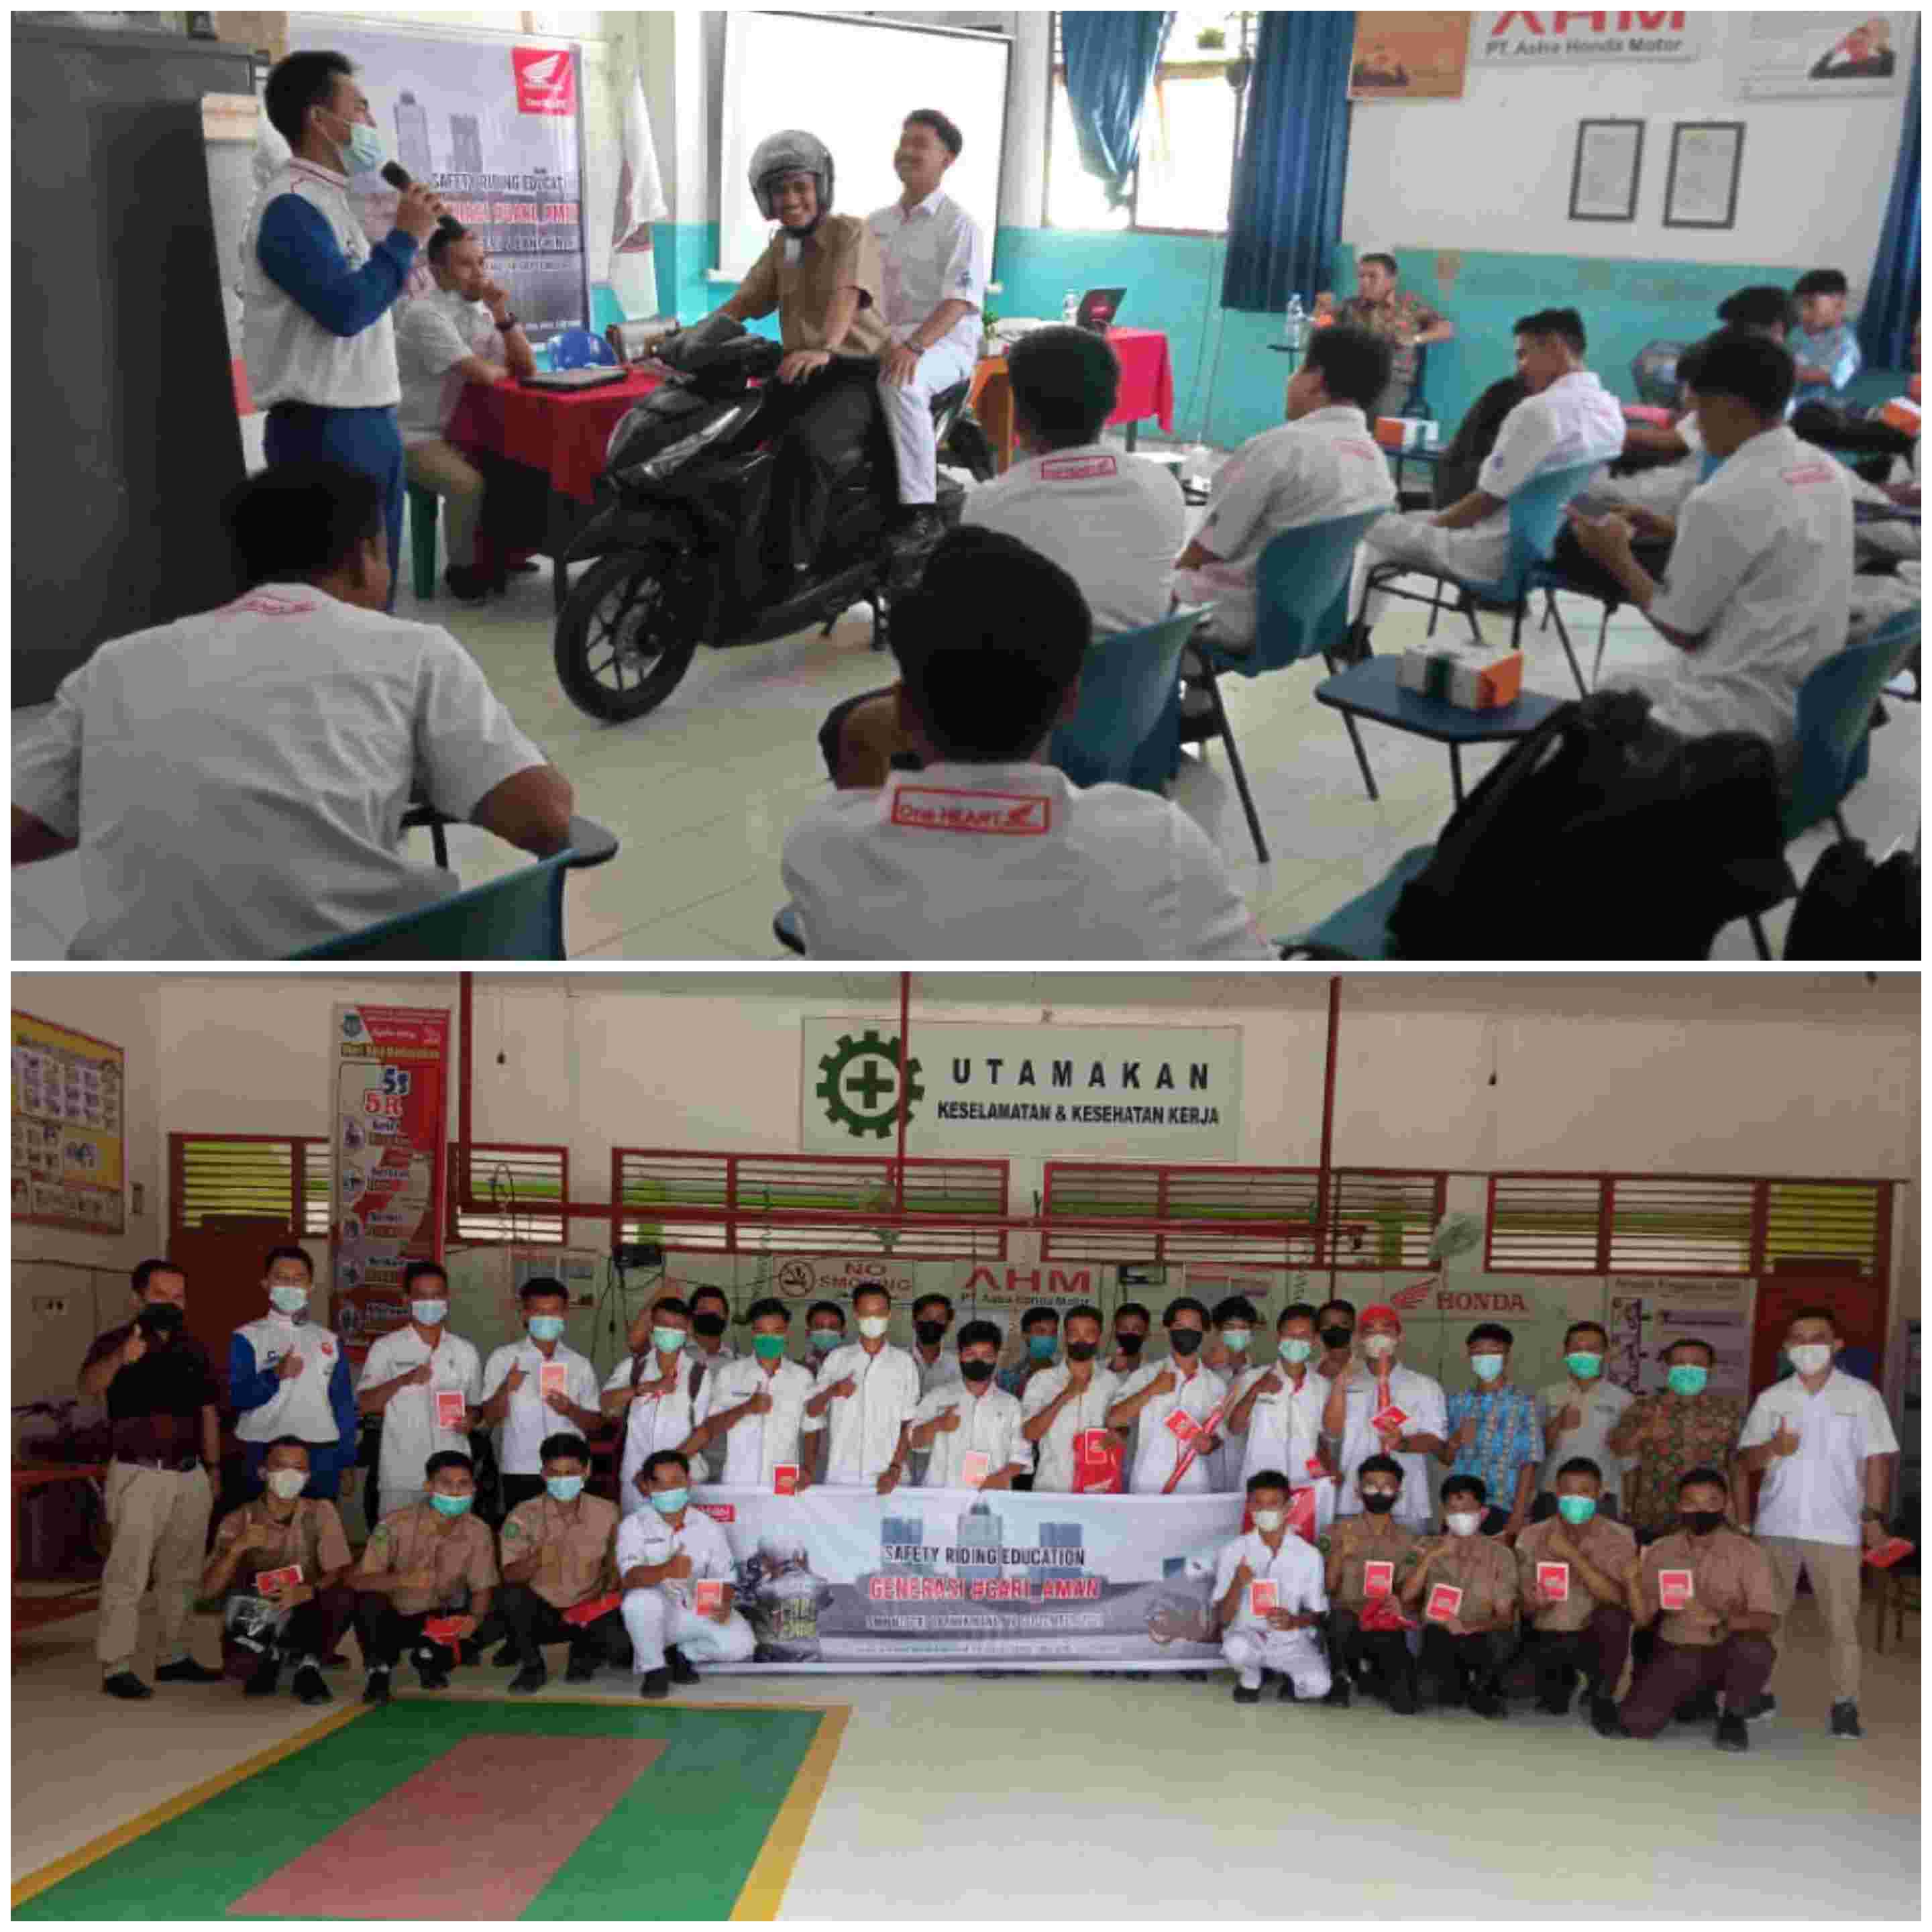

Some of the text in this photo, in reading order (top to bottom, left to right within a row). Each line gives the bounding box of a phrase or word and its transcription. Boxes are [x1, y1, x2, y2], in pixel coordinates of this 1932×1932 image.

[1629, 37, 1682, 52] Motor
[953, 1058, 1208, 1090] UTAMAKAN
[938, 1101, 1220, 1126] KESELAMATAN & KESEHATAN KERJA
[963, 1266, 1091, 1293] AHM
[1436, 1292, 1525, 1310] HONDA
[884, 1545, 1085, 1566] SAFETY RIDING EDUCATION
[869, 1577, 966, 1600] GENERASI
